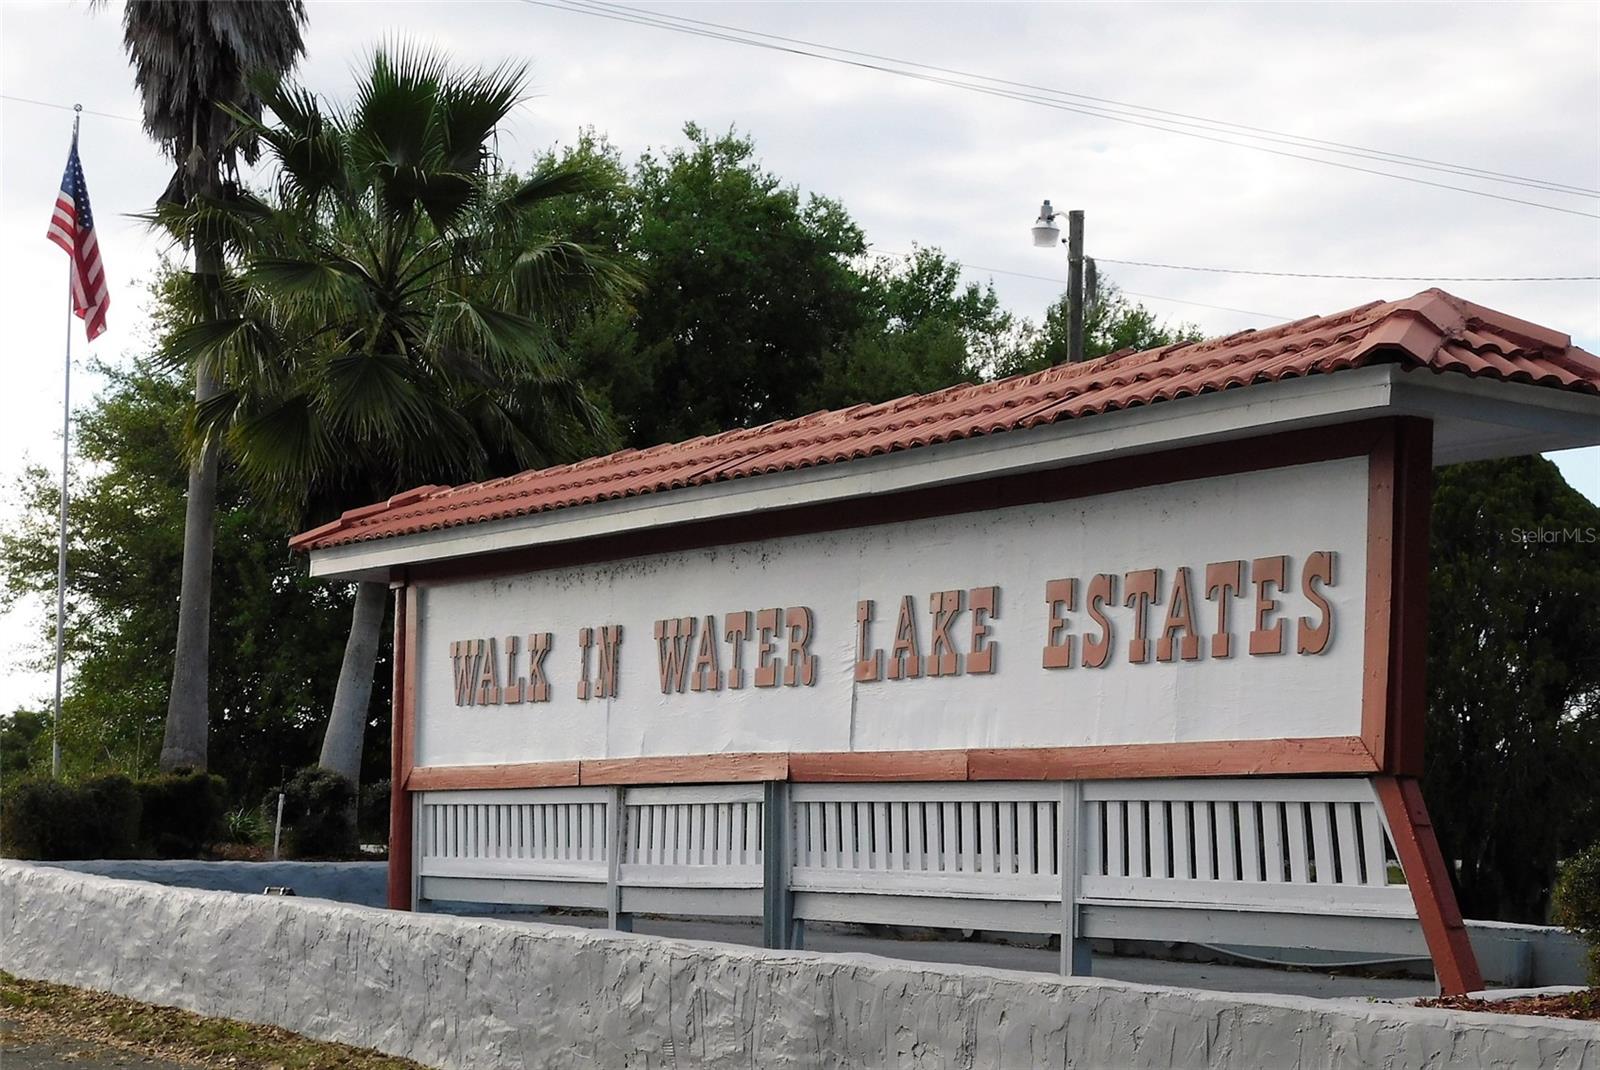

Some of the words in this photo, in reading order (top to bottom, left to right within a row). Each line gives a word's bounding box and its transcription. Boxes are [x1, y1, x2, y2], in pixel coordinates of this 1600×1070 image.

[450, 633, 552, 706] WALK
[578, 625, 624, 700] IN
[653, 605, 818, 694] WATER
[855, 586, 1001, 683] LAKE
[1042, 551, 1338, 671] ESTATES
